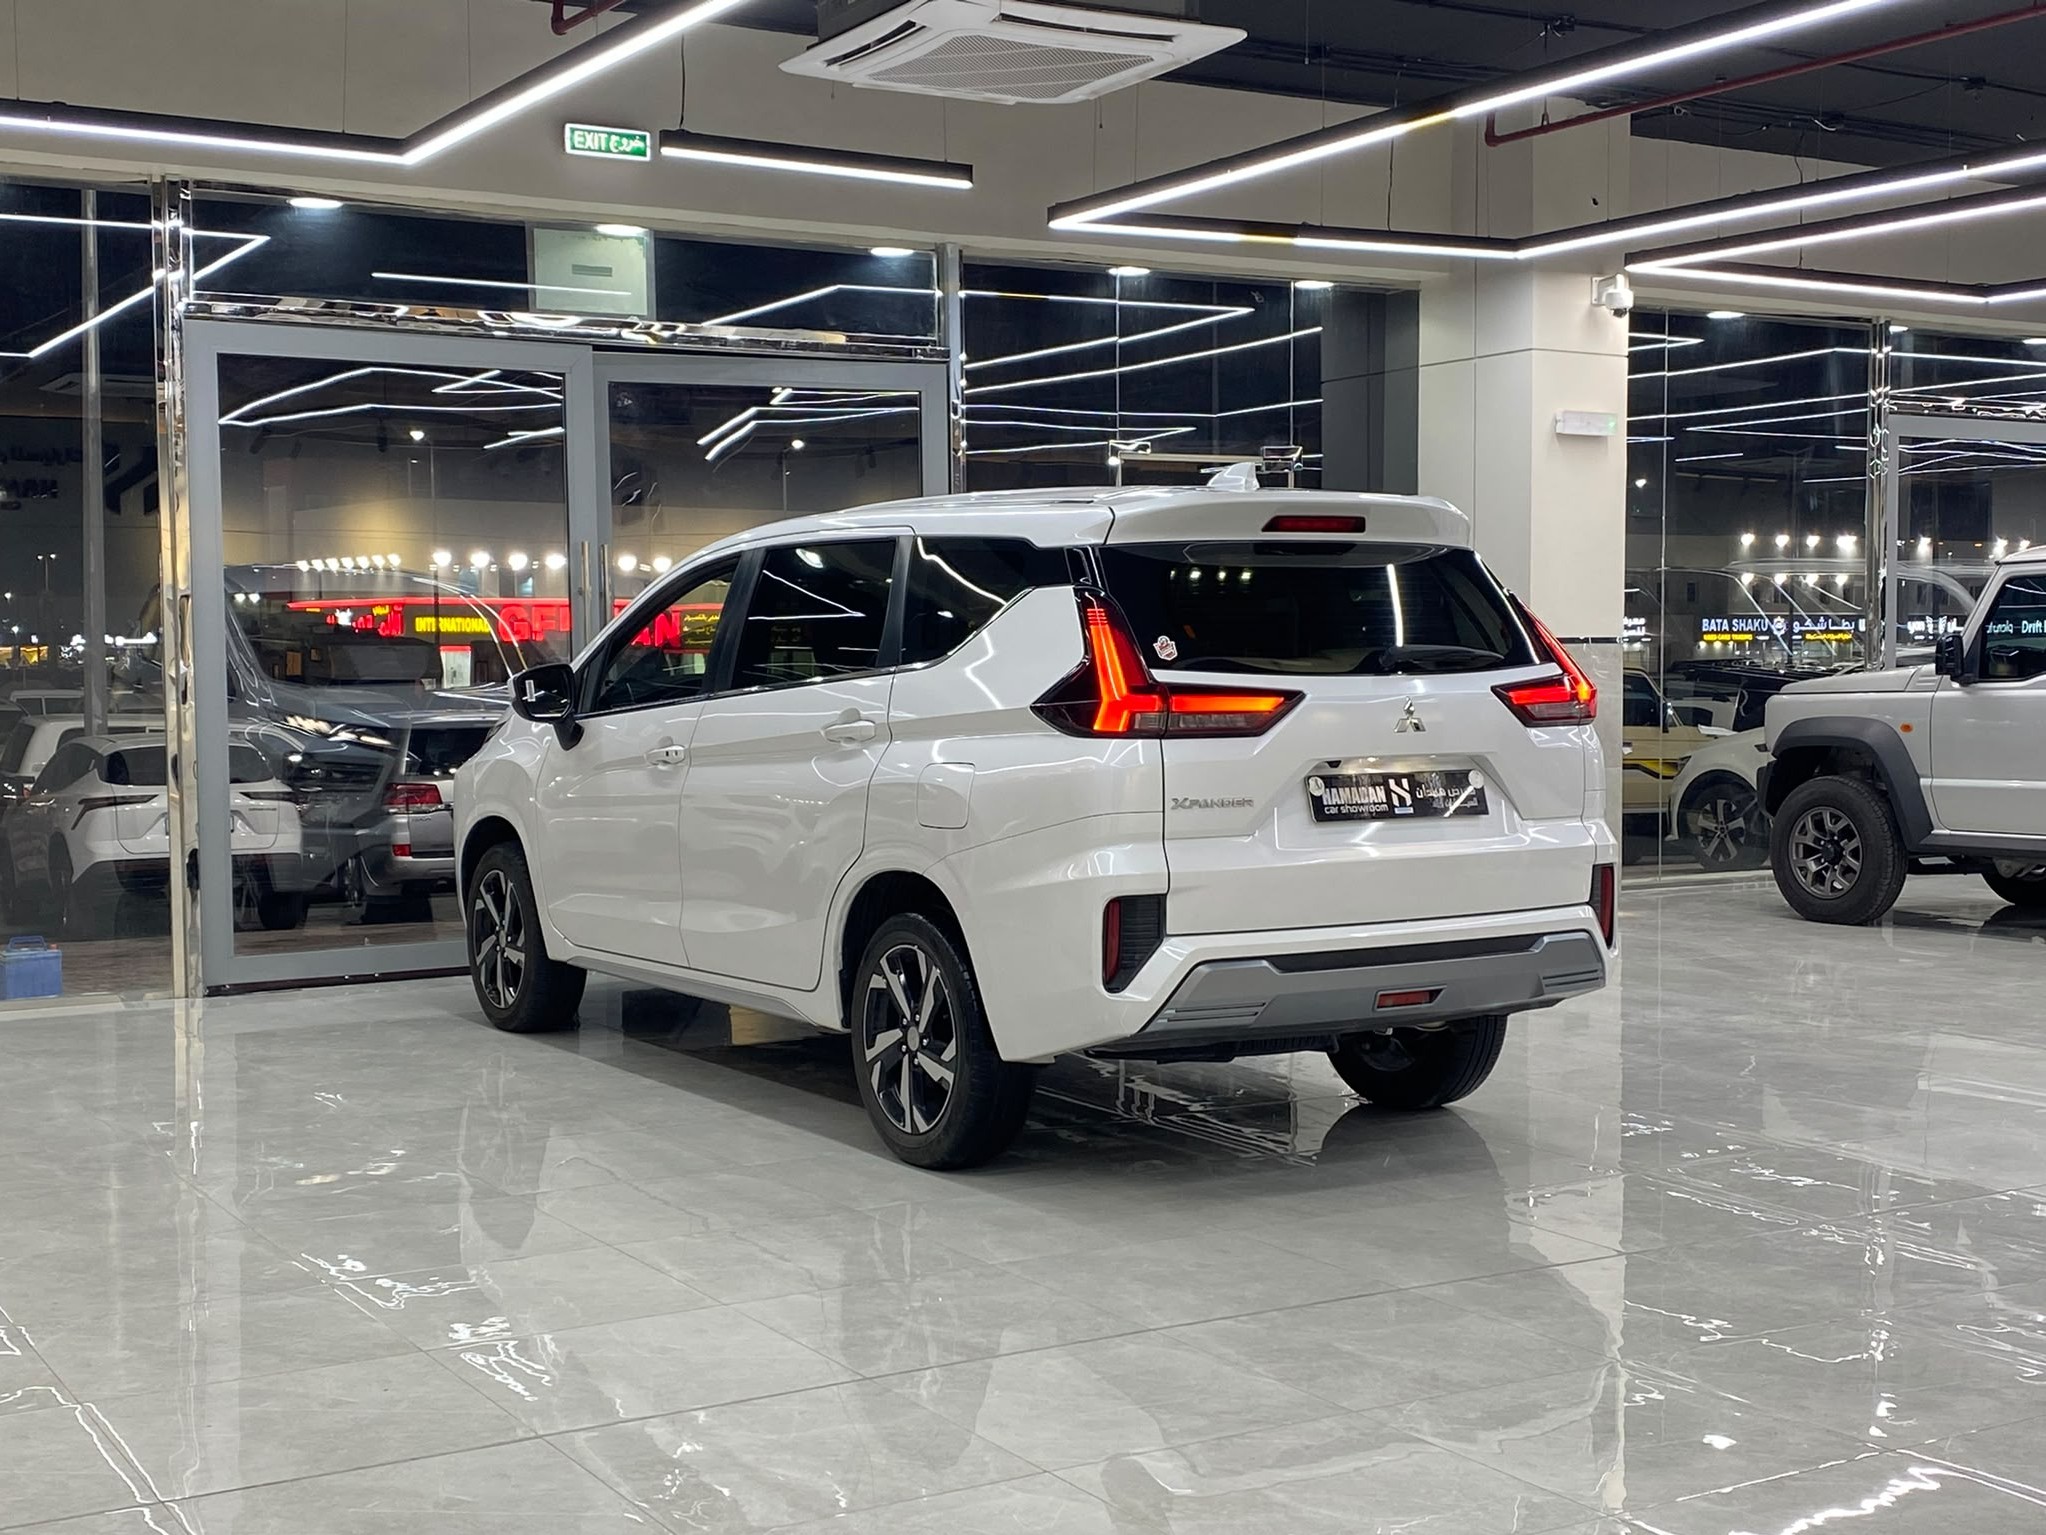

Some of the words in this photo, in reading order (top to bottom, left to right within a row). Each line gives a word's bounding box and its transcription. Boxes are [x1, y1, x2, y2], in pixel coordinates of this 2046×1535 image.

[573, 130, 608, 151] EXIT
[609, 134, 645, 153] خروج
[1702, 618, 1729, 632] BATA
[1732, 618, 1769, 632] SHAKU
[2021, 619, 2042, 634] Drift
[1322, 785, 1387, 806] HAMADAN
[1170, 798, 1255, 811] XPANDER
[1324, 806, 1339, 814] car
[1340, 803, 1389, 813] showroom
